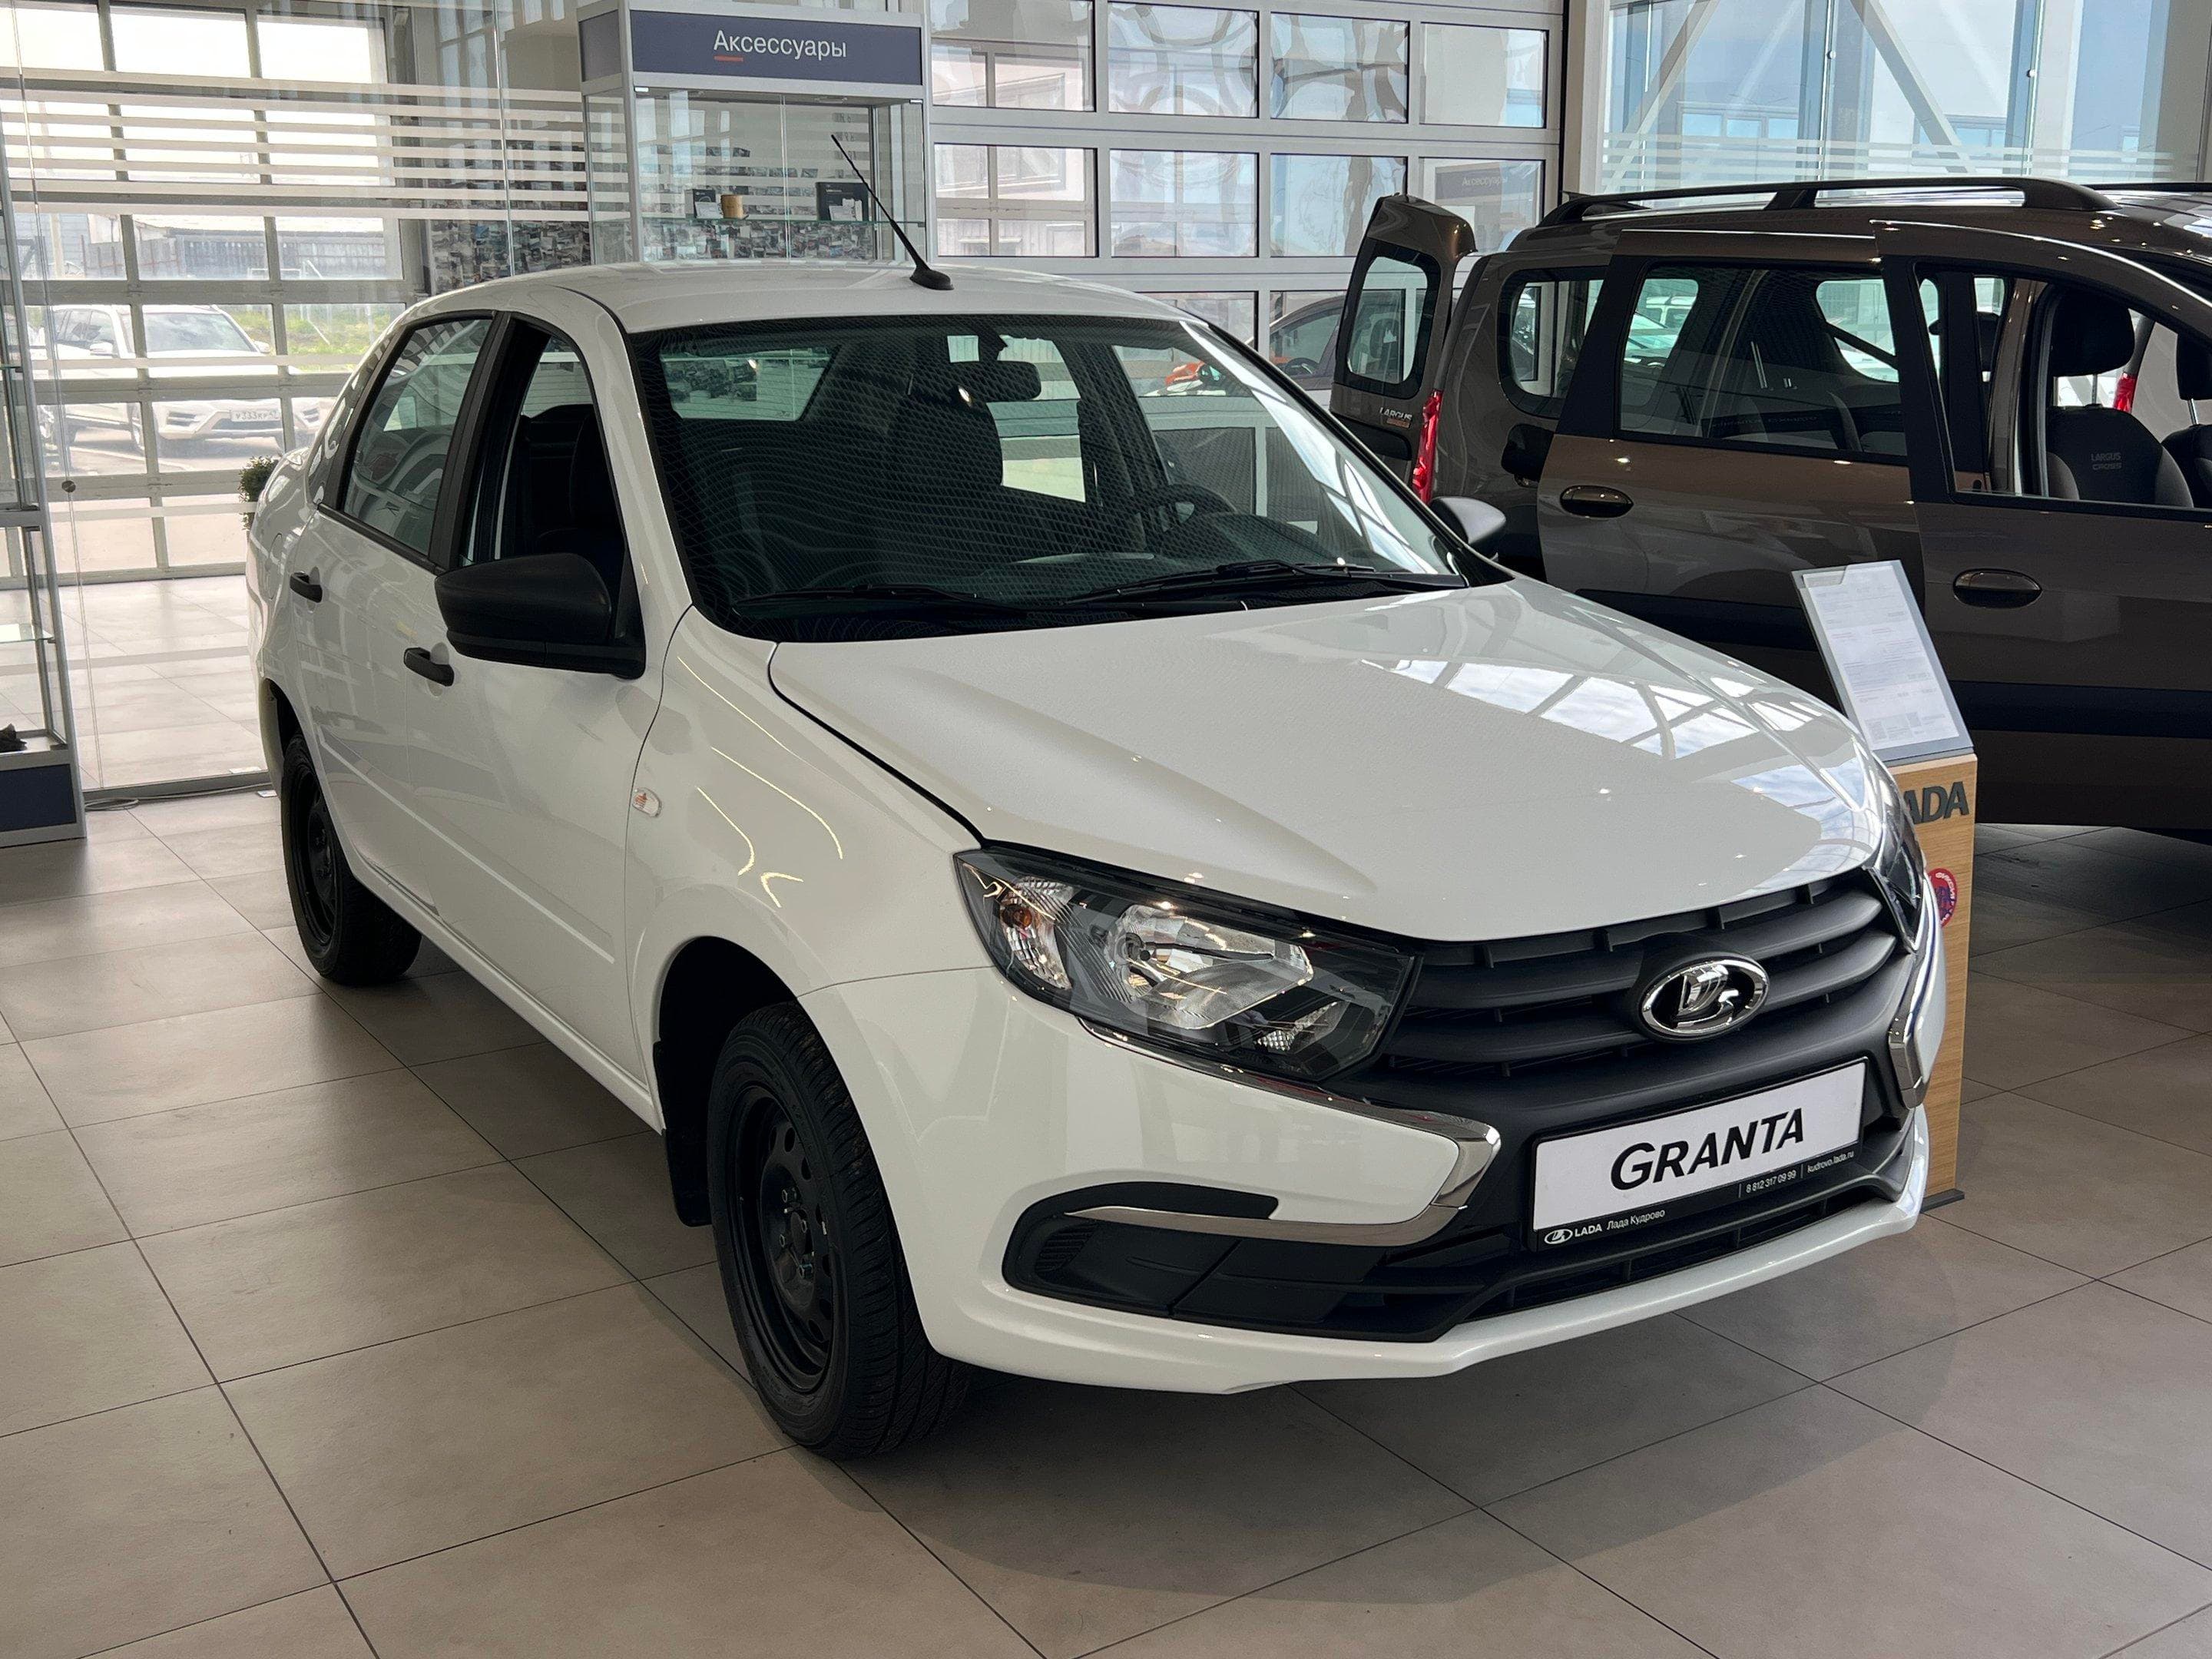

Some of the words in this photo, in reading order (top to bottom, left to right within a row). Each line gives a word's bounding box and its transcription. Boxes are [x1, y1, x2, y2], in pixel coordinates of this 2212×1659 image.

[714, 29, 846, 61] Аксессуары
[1903, 781, 1969, 825] ADA
[1611, 1108, 1803, 1190] GRANTA
[1807, 1151, 1854, 1174] kudrovo.lada.ru
[1764, 1176, 1777, 1187] 317
[1575, 1224, 1602, 1237] LADA
[1607, 1220, 1629, 1230] Лада
[1630, 1210, 1665, 1225] Кудрово
